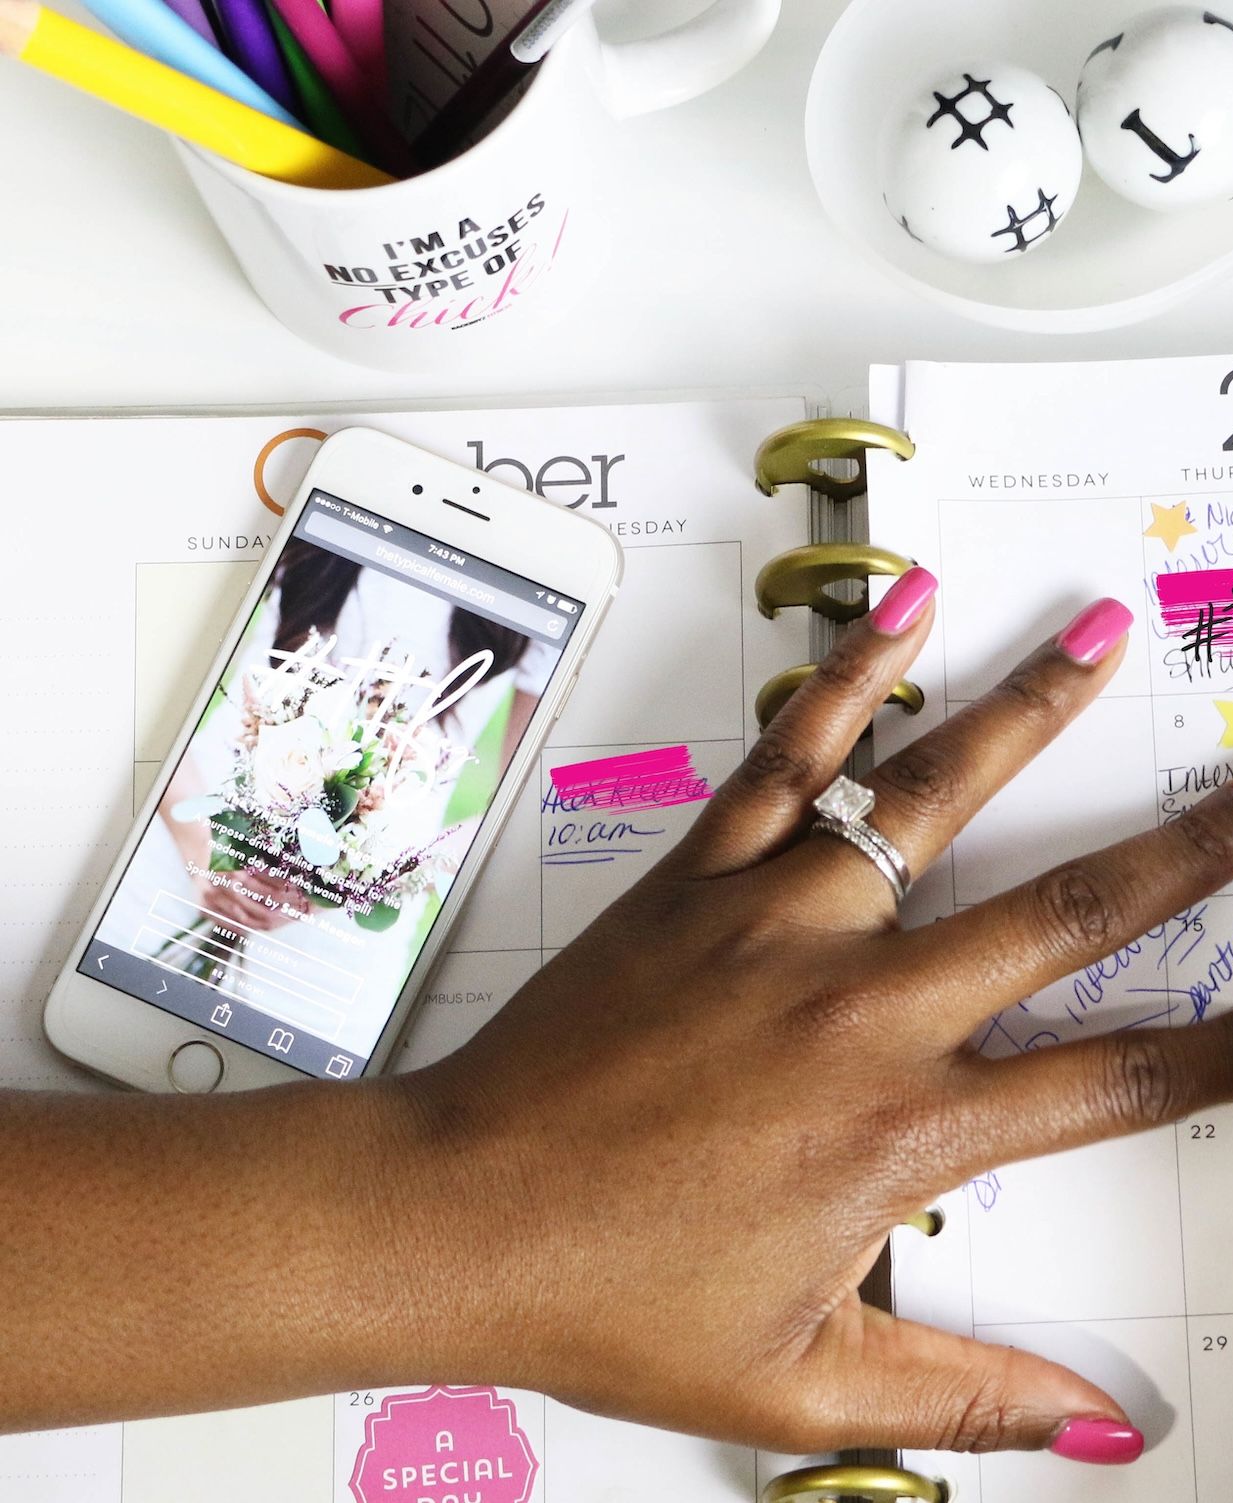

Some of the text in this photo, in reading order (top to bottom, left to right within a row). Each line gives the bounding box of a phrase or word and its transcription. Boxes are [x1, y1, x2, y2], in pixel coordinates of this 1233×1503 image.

[323, 192, 546, 284] NO EXCUSES
[382, 217, 481, 260] I'M A
[374, 239, 523, 304] TYPE OF
[968, 472, 1110, 489] WEDNESDAY
[341, 507, 381, 530] T-Mobile
[426, 543, 466, 567] 7:43 PM
[1174, 714, 1185, 728] 8
[207, 838, 245, 860] modern
[246, 855, 267, 872] day
[268, 864, 288, 881] girl
[288, 874, 310, 889] who
[312, 884, 342, 903] wants
[282, 851, 313, 871] online
[368, 888, 382, 901] for
[384, 896, 400, 909] the
[184, 861, 230, 890] Spotlight
[231, 882, 263, 902] Cover
[263, 895, 279, 912] by
[281, 903, 316, 925] Sarah
[213, 926, 235, 939] MEET
[1182, 918, 1204, 933] 15
[466, 991, 493, 1004] DAY
[1190, 1124, 1216, 1139] 22
[1202, 1336, 1228, 1351] 29
[349, 1391, 374, 1406] 26
[435, 1430, 454, 1453] A
[382, 1457, 513, 1490] SPECIAL
